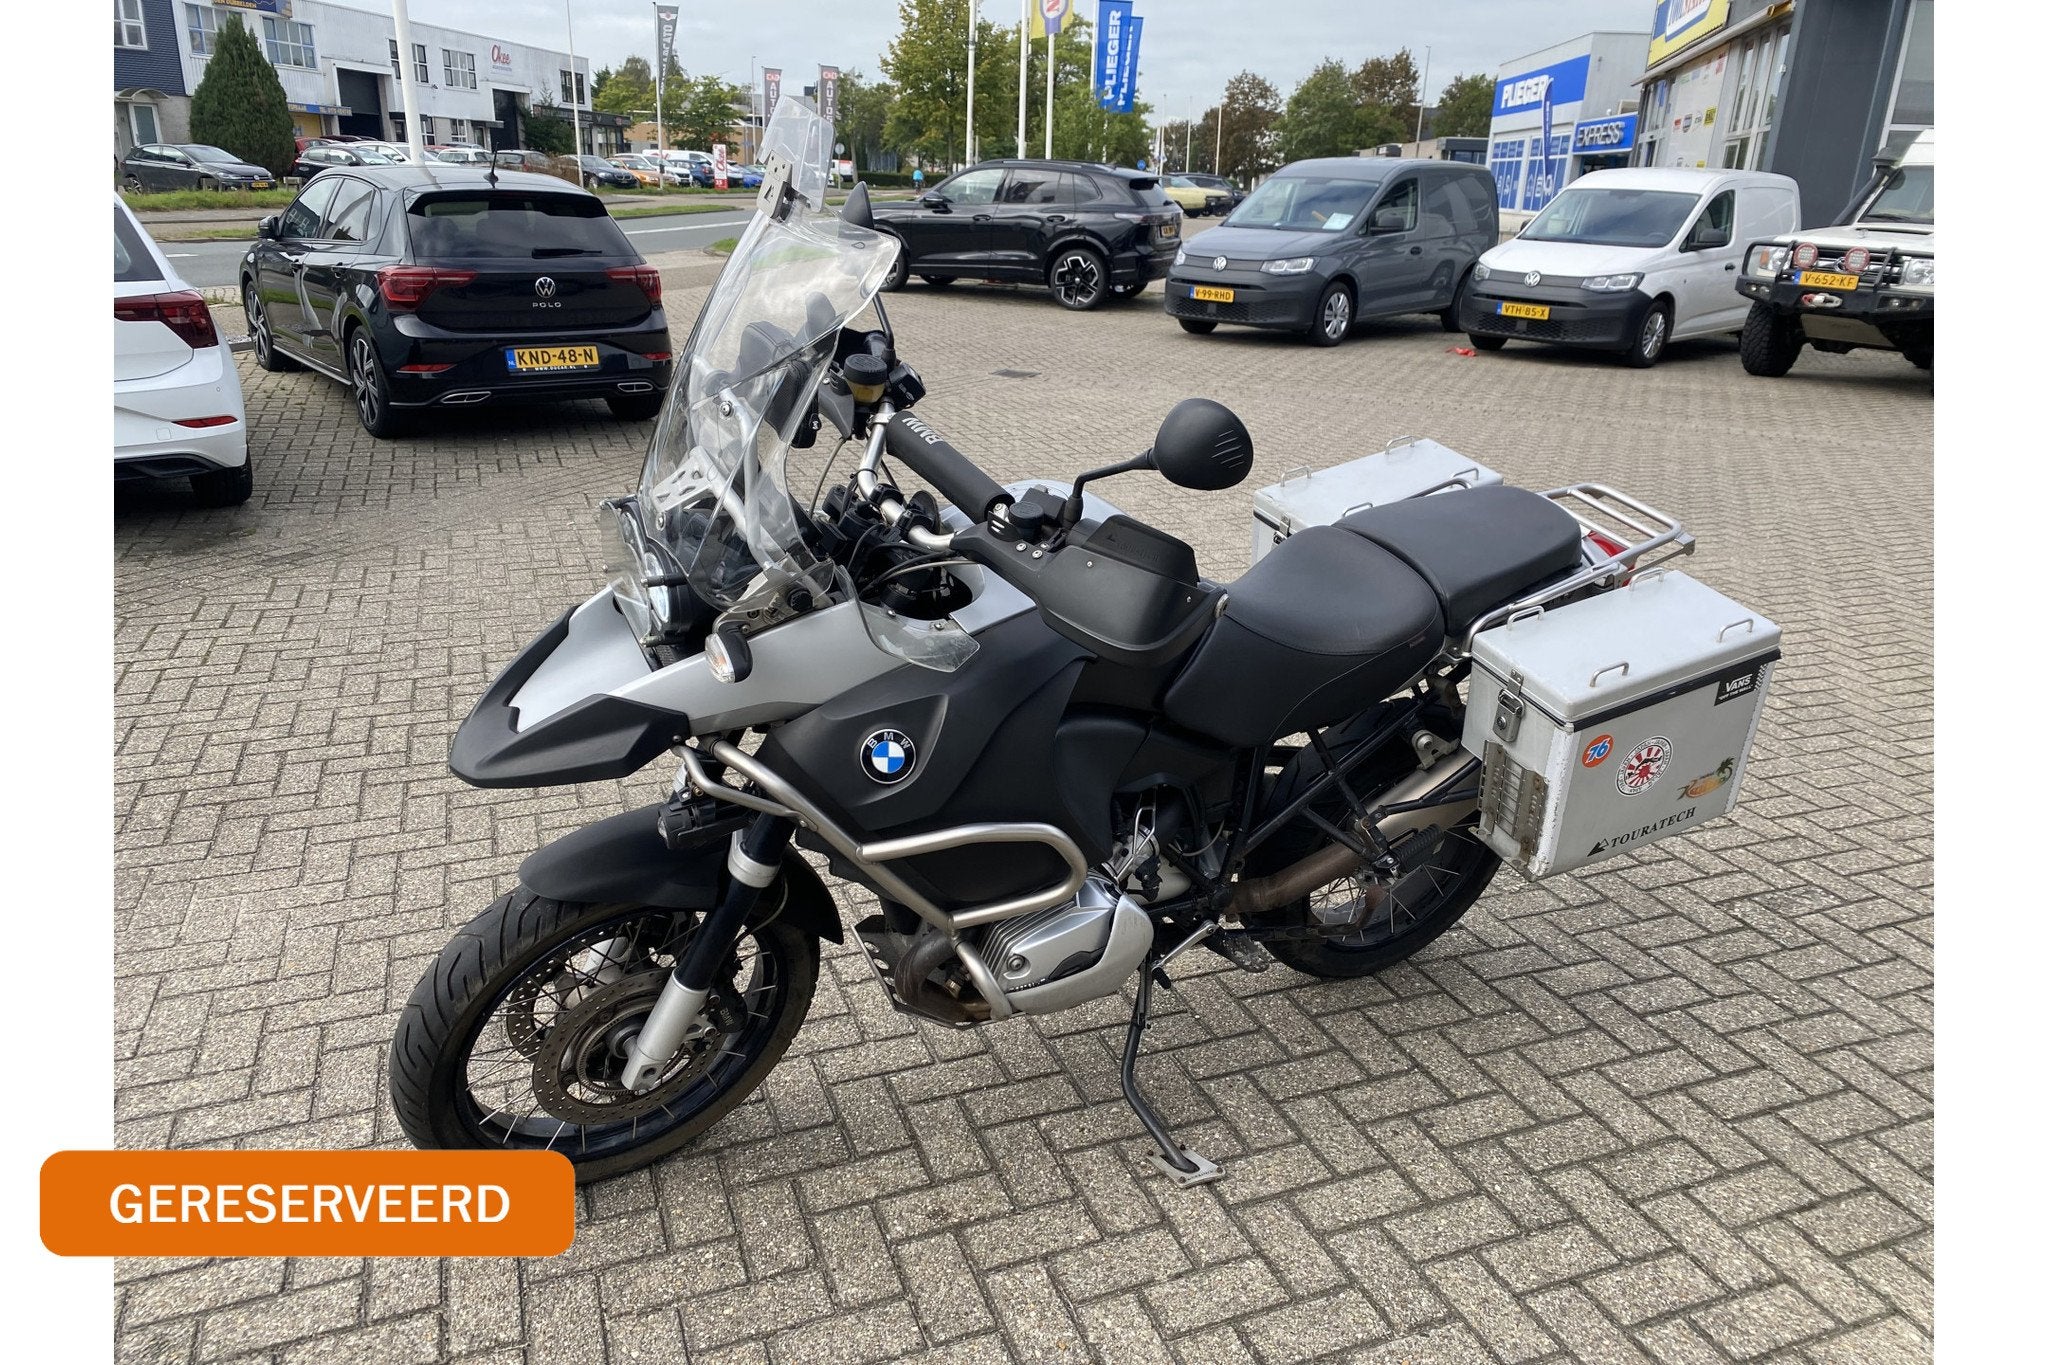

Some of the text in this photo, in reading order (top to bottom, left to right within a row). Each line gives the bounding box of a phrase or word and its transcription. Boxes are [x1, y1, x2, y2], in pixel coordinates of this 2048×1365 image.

[1103, 10, 1122, 100] PLIEGER
[1576, 121, 1625, 147] EXPRESS
[1804, 273, 1856, 287] V-652-KF
[1195, 288, 1231, 300] V-99-RHD
[1504, 304, 1546, 317] VTH-85-X
[517, 348, 594, 366] KND-48-N
[902, 417, 944, 445] BMW
[1725, 673, 1753, 692] VANS
[866, 732, 911, 749] BMW
[1584, 738, 1611, 764] 76
[1610, 806, 1697, 848] TOURATECH
